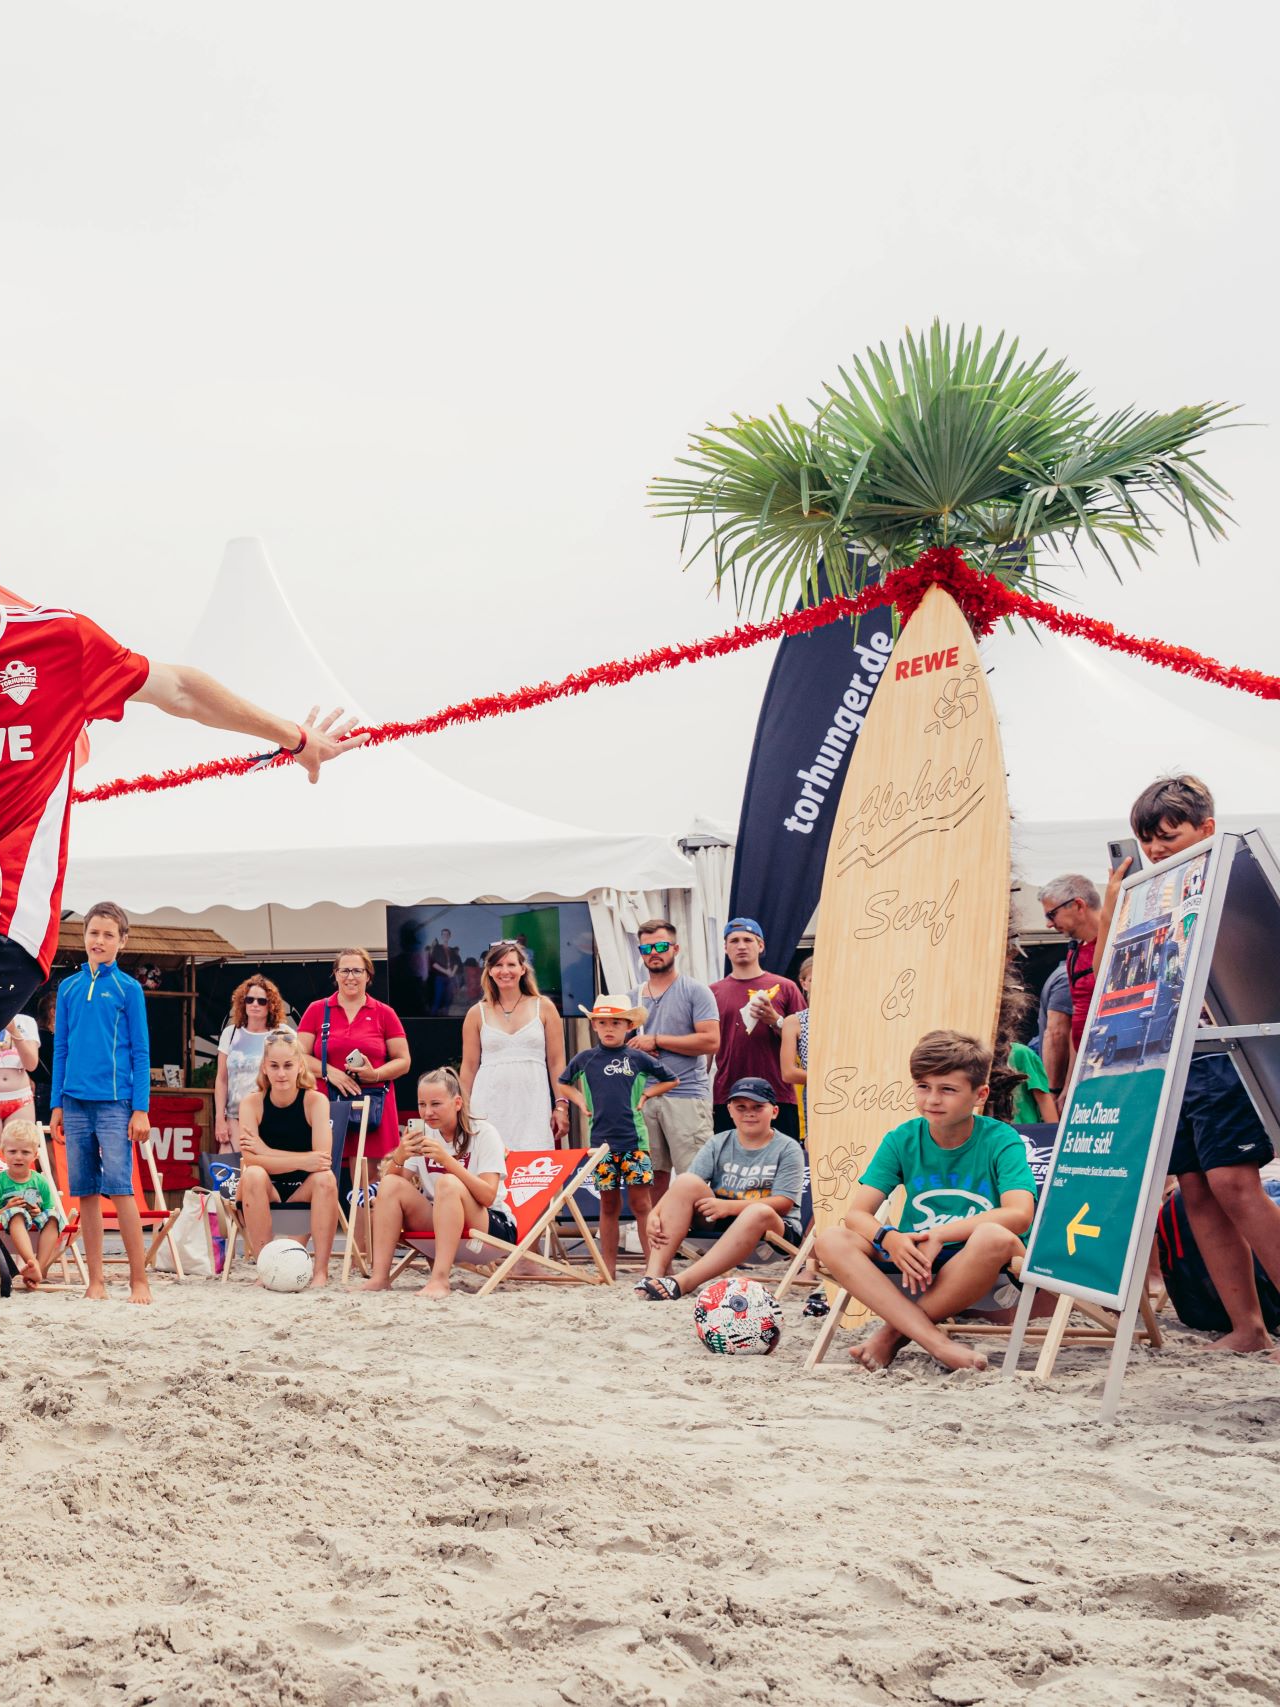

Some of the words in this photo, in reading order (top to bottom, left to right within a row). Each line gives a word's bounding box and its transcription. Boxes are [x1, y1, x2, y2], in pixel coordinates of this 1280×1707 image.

[0, 676, 36, 688] TORHUNGER
[895, 646, 959, 682] REWE
[784, 631, 894, 834] torhunger.de
[838, 738, 983, 850] Aloha!
[854, 879, 960, 946] Surf
[880, 968, 916, 1020] &
[813, 1066, 920, 1114] Snac
[1070, 1104, 1092, 1124] Deine
[1062, 1132, 1074, 1152] Es
[1072, 1131, 1094, 1153] lohnt
